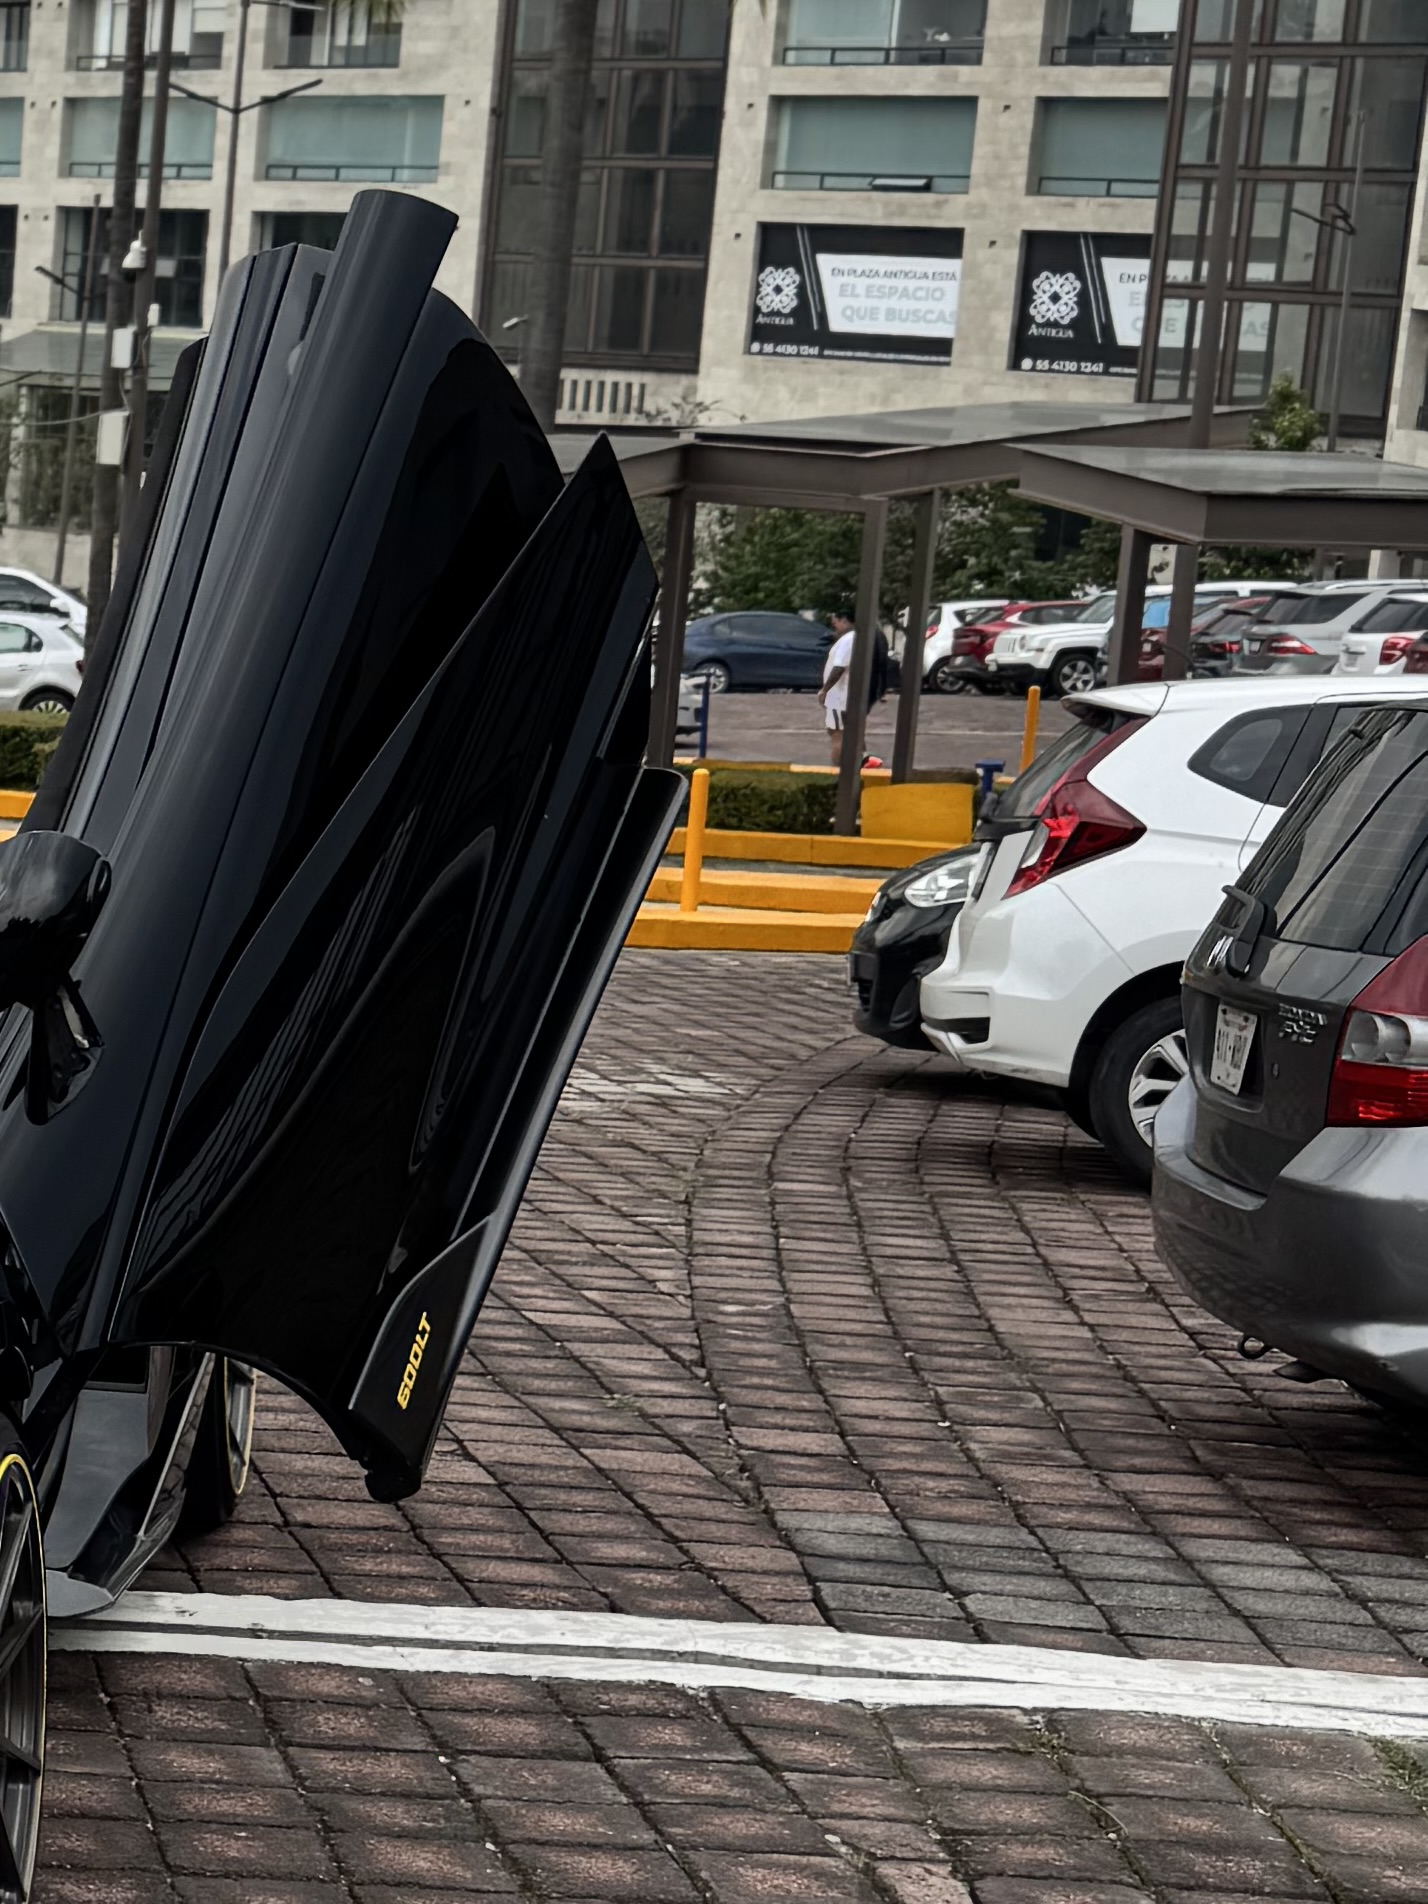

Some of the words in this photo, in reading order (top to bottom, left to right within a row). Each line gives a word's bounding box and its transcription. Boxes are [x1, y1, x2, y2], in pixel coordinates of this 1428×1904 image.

[831, 267, 844, 277] EN
[846, 268, 880, 279] PLAZA
[882, 270, 929, 281] ANTIGUA
[1119, 272, 1136, 284] EN
[838, 282, 860, 299] EL
[864, 283, 945, 302] ESPACIO
[841, 305, 883, 323] QUE
[884, 306, 956, 326] BUSCAS
[397, 1311, 431, 1410] 600LT
